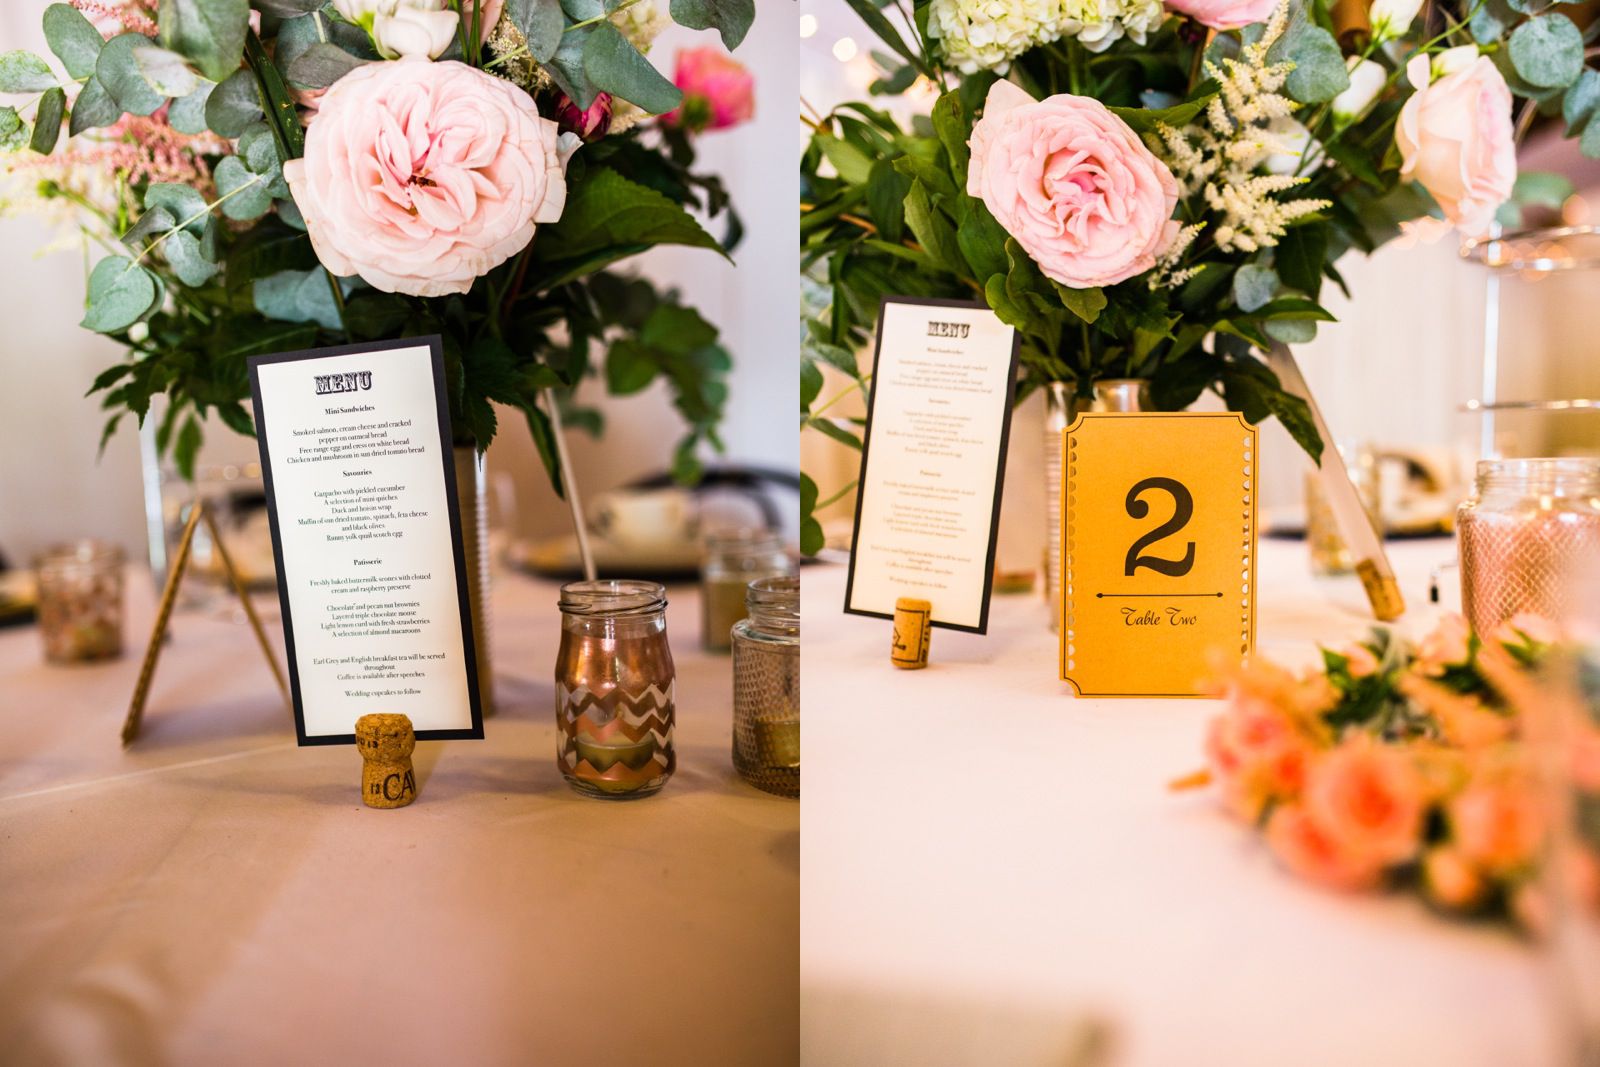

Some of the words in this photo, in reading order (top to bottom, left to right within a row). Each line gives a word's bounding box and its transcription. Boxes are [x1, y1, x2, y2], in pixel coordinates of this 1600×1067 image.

[927, 321, 971, 339] MENU
[314, 370, 373, 395] MENU
[324, 406, 340, 414] Mini
[339, 404, 375, 413] Sandwiches
[292, 427, 316, 436] Smoked
[356, 423, 376, 431] cheese
[376, 421, 388, 429] and
[388, 419, 411, 428] cracked
[318, 436, 339, 445] pepper
[370, 431, 388, 439] bread
[313, 446, 329, 454] range
[329, 445, 341, 453] egg
[340, 442, 352, 450] and
[376, 440, 392, 448] white
[392, 438, 410, 446] bread
[286, 455, 311, 463] Chicken
[310, 454, 322, 462] and
[322, 452, 353, 461] mushroom
[370, 449, 387, 457] dried
[387, 448, 408, 456] tomato
[408, 446, 425, 454] bread
[342, 469, 372, 477] Savouries
[342, 487, 355, 495] with
[354, 486, 377, 496] pickled
[376, 484, 405, 493] cucumber
[329, 497, 355, 505] selection
[361, 495, 375, 503] mini
[375, 494, 398, 504] quiches
[331, 506, 347, 514] Duck
[347, 505, 359, 513] and
[334, 514, 350, 522] dried
[408, 510, 428, 518] cheese
[341, 523, 352, 531] and
[352, 522, 368, 531] black
[368, 522, 385, 530] olives
[1124, 477, 1196, 577] 2
[326, 534, 344, 542] Runny
[345, 532, 357, 542] yolk
[357, 531, 372, 541] quail
[391, 531, 403, 539] egg
[353, 558, 382, 566] Patisserie
[309, 578, 330, 587] Freshly
[330, 577, 348, 585] baked
[398, 574, 411, 582] with
[410, 572, 431, 581] clotted
[348, 585, 359, 593] and
[359, 584, 386, 594] raspberry
[386, 584, 411, 593] preserve
[355, 602, 366, 610] and
[365, 604, 383, 612] pecan
[394, 601, 420, 609] brownies
[332, 612, 354, 621] Layered
[370, 610, 397, 618] chocolate
[1120, 607, 1161, 626] Table
[1165, 607, 1197, 626] Two
[320, 621, 336, 630] Light
[354, 620, 368, 628] curd
[368, 619, 381, 627] with
[380, 619, 396, 627] fresh
[395, 618, 430, 626] strawberries
[337, 630, 362, 638] selection
[313, 657, 325, 665] Earl
[325, 657, 339, 666] Grey
[339, 656, 350, 664] and
[350, 655, 372, 665] English
[372, 654, 398, 662] breakfast
[407, 653, 418, 661] will
[426, 652, 445, 660] served
[364, 662, 395, 672] throughout
[336, 672, 355, 680] Coffee
[361, 671, 385, 679] available
[385, 671, 399, 679] after
[399, 670, 425, 680] speeches
[344, 688, 370, 698] Wedding
[370, 688, 396, 697] cupcakes
[403, 687, 421, 695] follow
